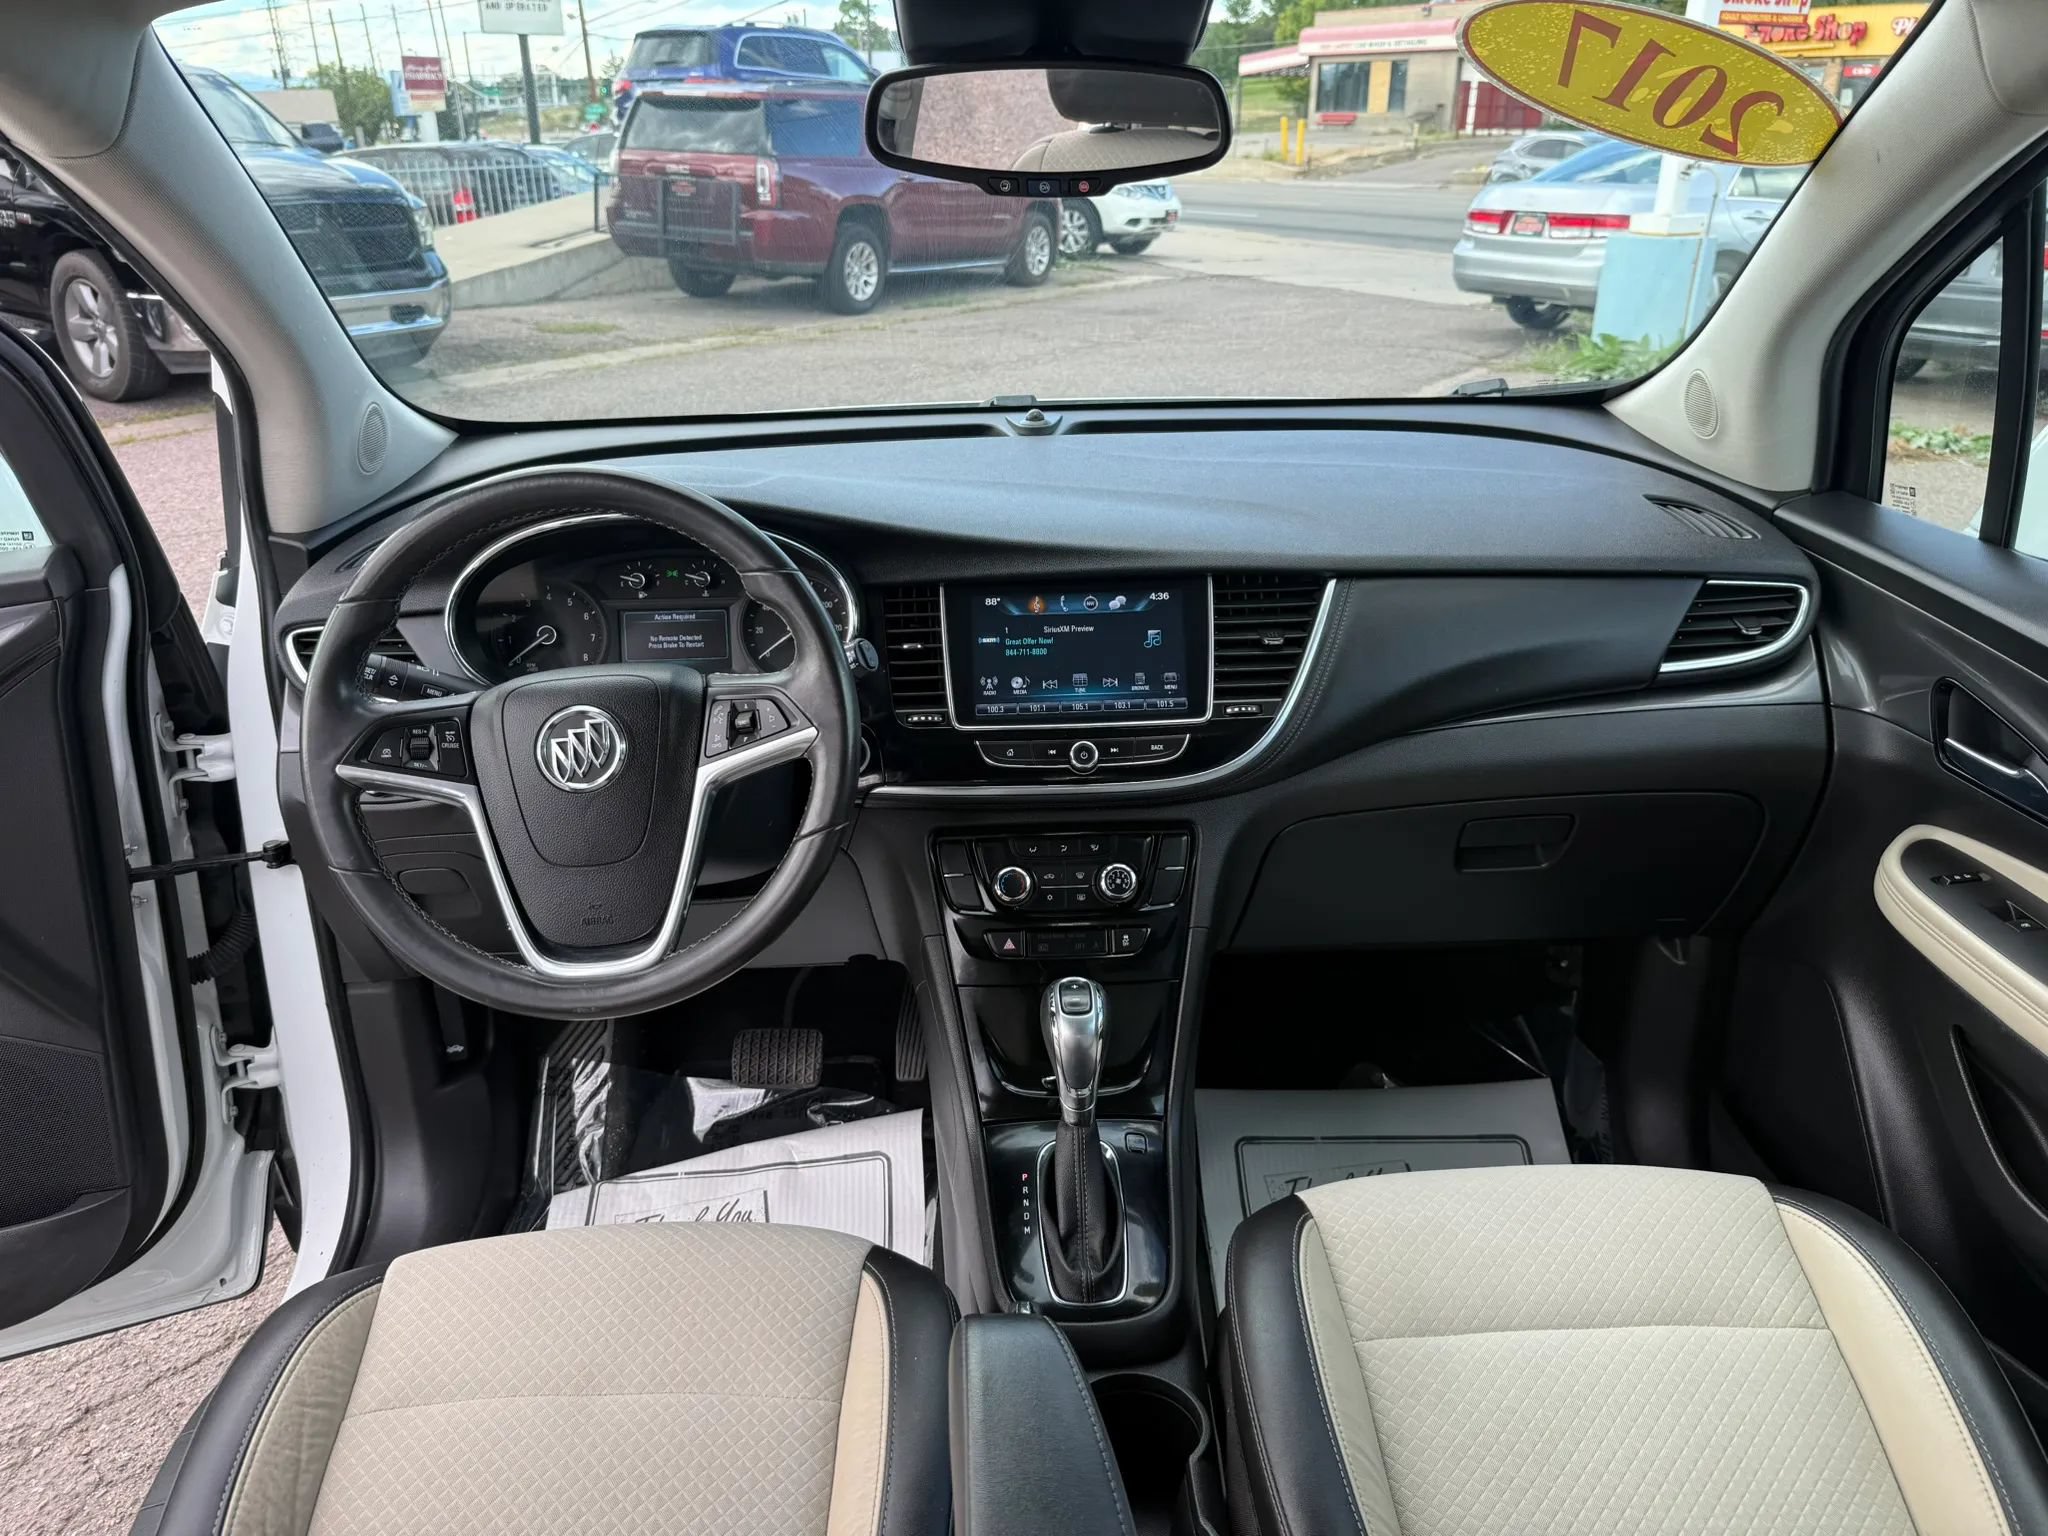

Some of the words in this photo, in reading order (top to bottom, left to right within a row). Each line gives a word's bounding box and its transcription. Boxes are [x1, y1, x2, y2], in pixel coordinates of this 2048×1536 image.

[1149, 592, 1170, 601] 4:36
[654, 613, 672, 621] Action
[672, 612, 696, 622] Required
[1043, 624, 1070, 633] SiriusXM
[1071, 624, 1095, 633] Preview
[679, 634, 703, 642] Detected
[1022, 637, 1037, 645] Offer
[1038, 637, 1054, 645] Now!
[648, 642, 663, 650] Press
[663, 641, 678, 649] Brake
[686, 640, 705, 648] Restart
[426, 687, 443, 697] MENU
[987, 705, 1004, 714] 100.3
[1029, 704, 1046, 712] 101.1
[1072, 703, 1088, 711] 105.1
[1114, 701, 1131, 709] 103.1
[1156, 700, 1174, 708] 101.5
[1022, 1173, 1028, 1182] P
[1022, 1186, 1029, 1194] R
[1023, 1198, 1030, 1207] N
[1023, 1212, 1030, 1221] D
[1024, 1226, 1031, 1235] M
